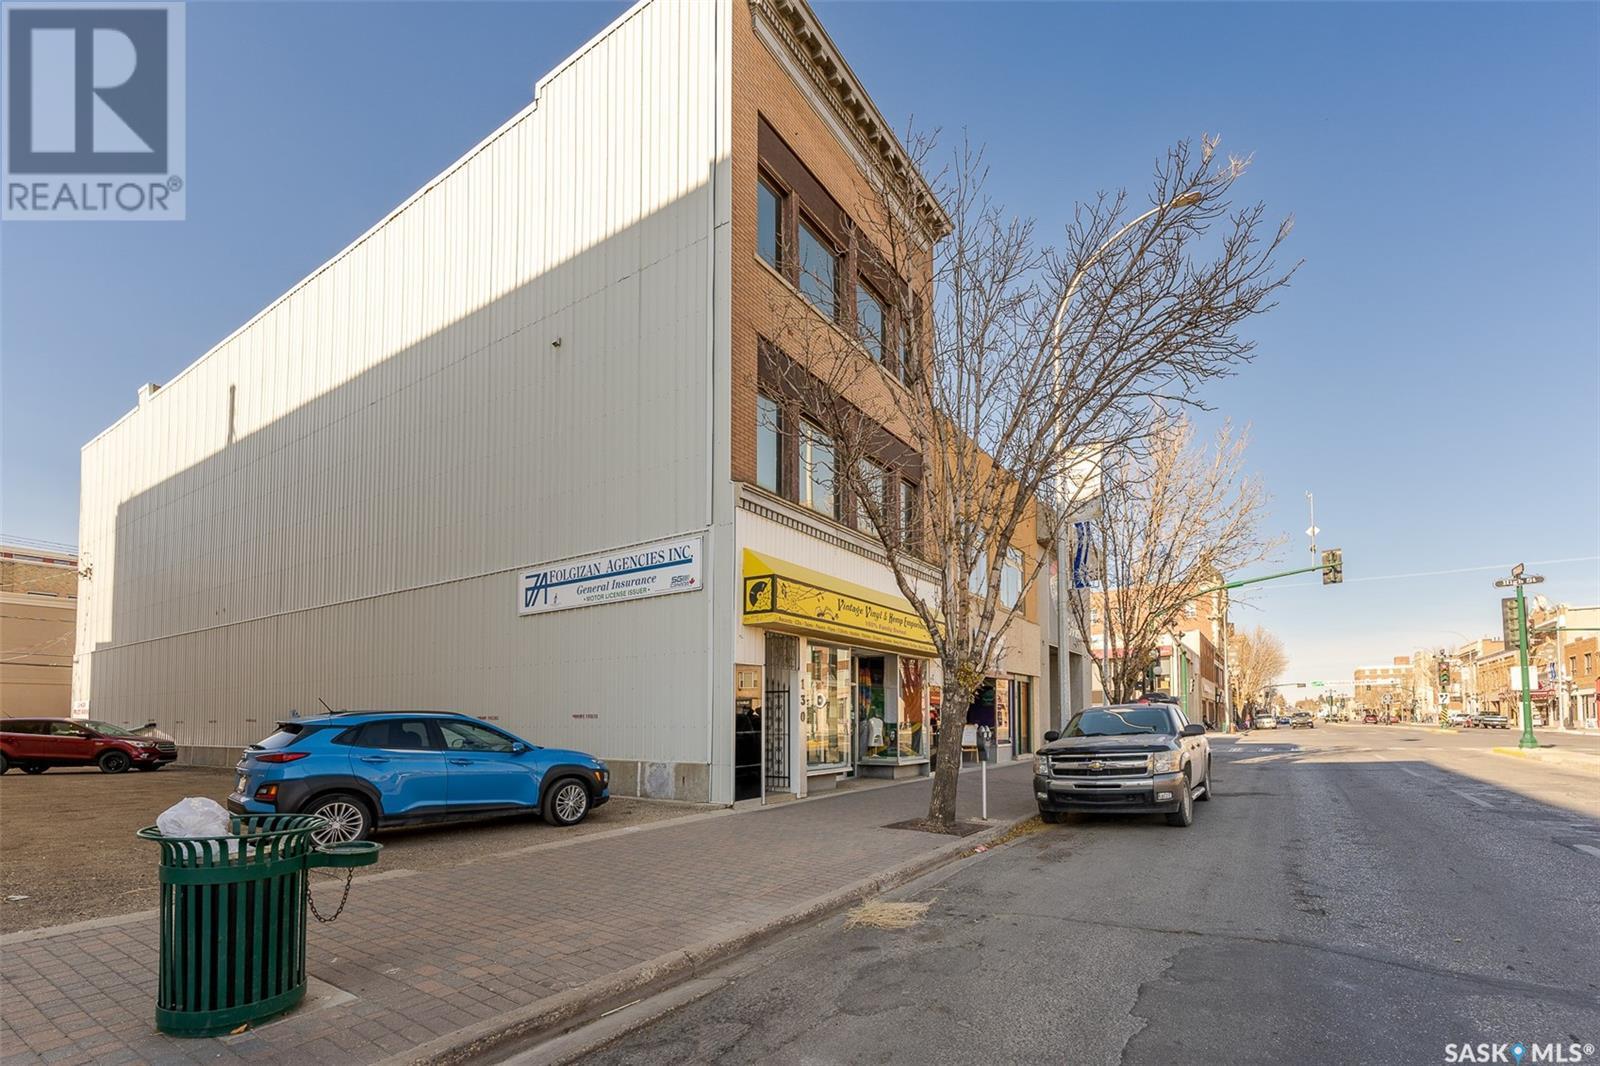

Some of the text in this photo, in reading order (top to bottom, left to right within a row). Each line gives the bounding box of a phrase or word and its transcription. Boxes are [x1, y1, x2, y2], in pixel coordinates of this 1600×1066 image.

[549, 545, 693, 583] FOLGIZAN AGENCIES INC.
[576, 575, 657, 595] General Insurance
[837, 598, 863, 617] Vintage
[865, 605, 883, 620] Vinyl
